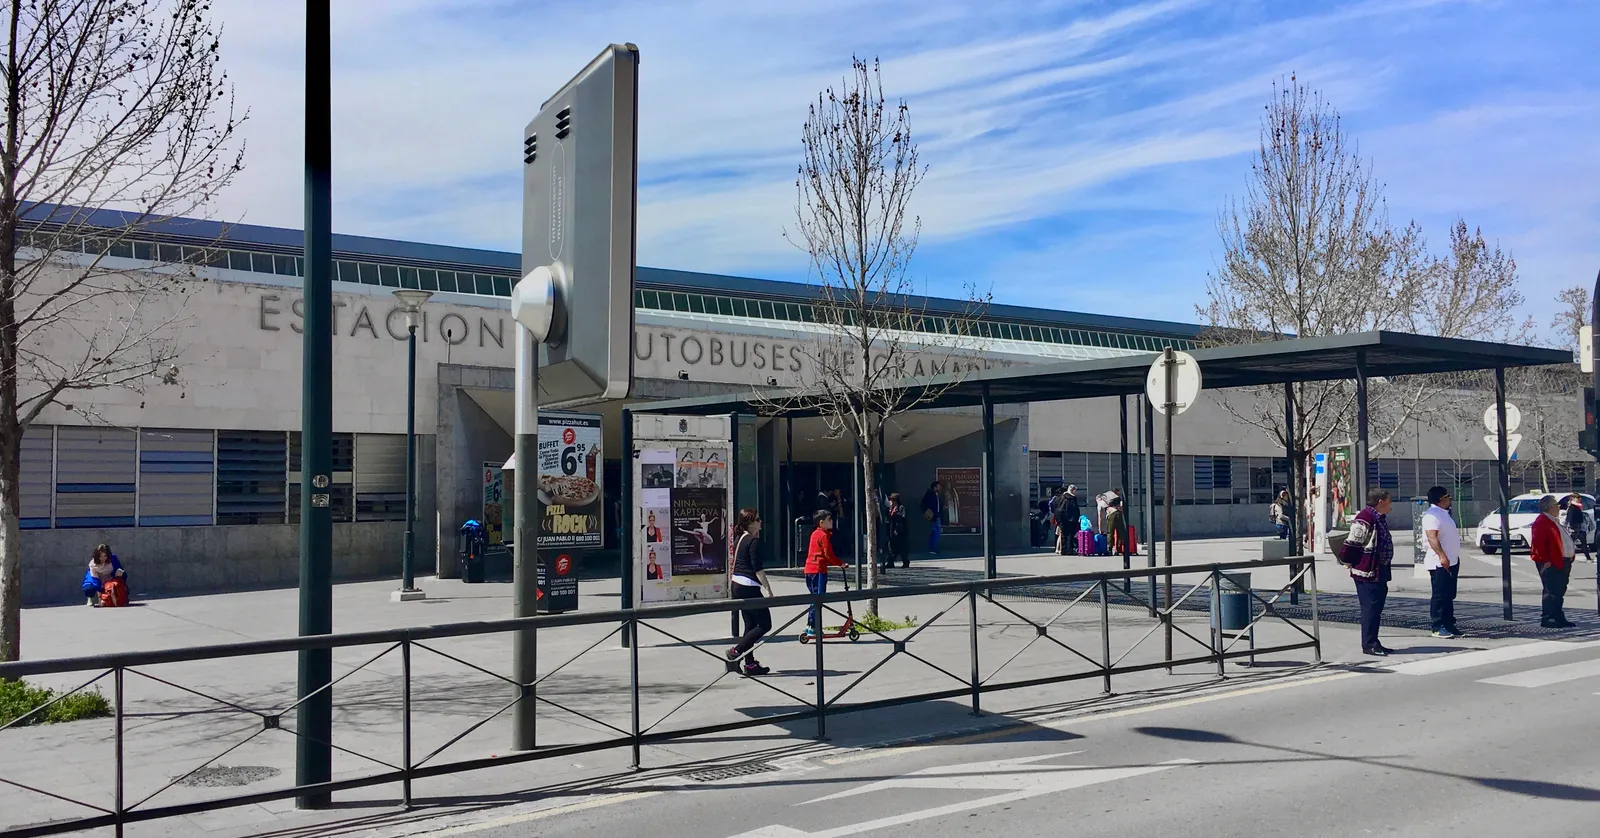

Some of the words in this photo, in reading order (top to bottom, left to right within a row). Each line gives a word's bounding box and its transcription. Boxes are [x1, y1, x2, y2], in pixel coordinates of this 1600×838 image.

[261, 295, 504, 348] ESTACION
[634, 331, 803, 373] UTOBUSES
[539, 440, 560, 450] BUFFET
[576, 443, 586, 452] 95
[561, 446, 578, 476] 6
[577, 452, 584, 464] €
[674, 500, 698, 508] NINA
[546, 505, 565, 516] PIZZA
[674, 508, 719, 516] KAPTSOVA
[553, 514, 588, 533] ROCK
